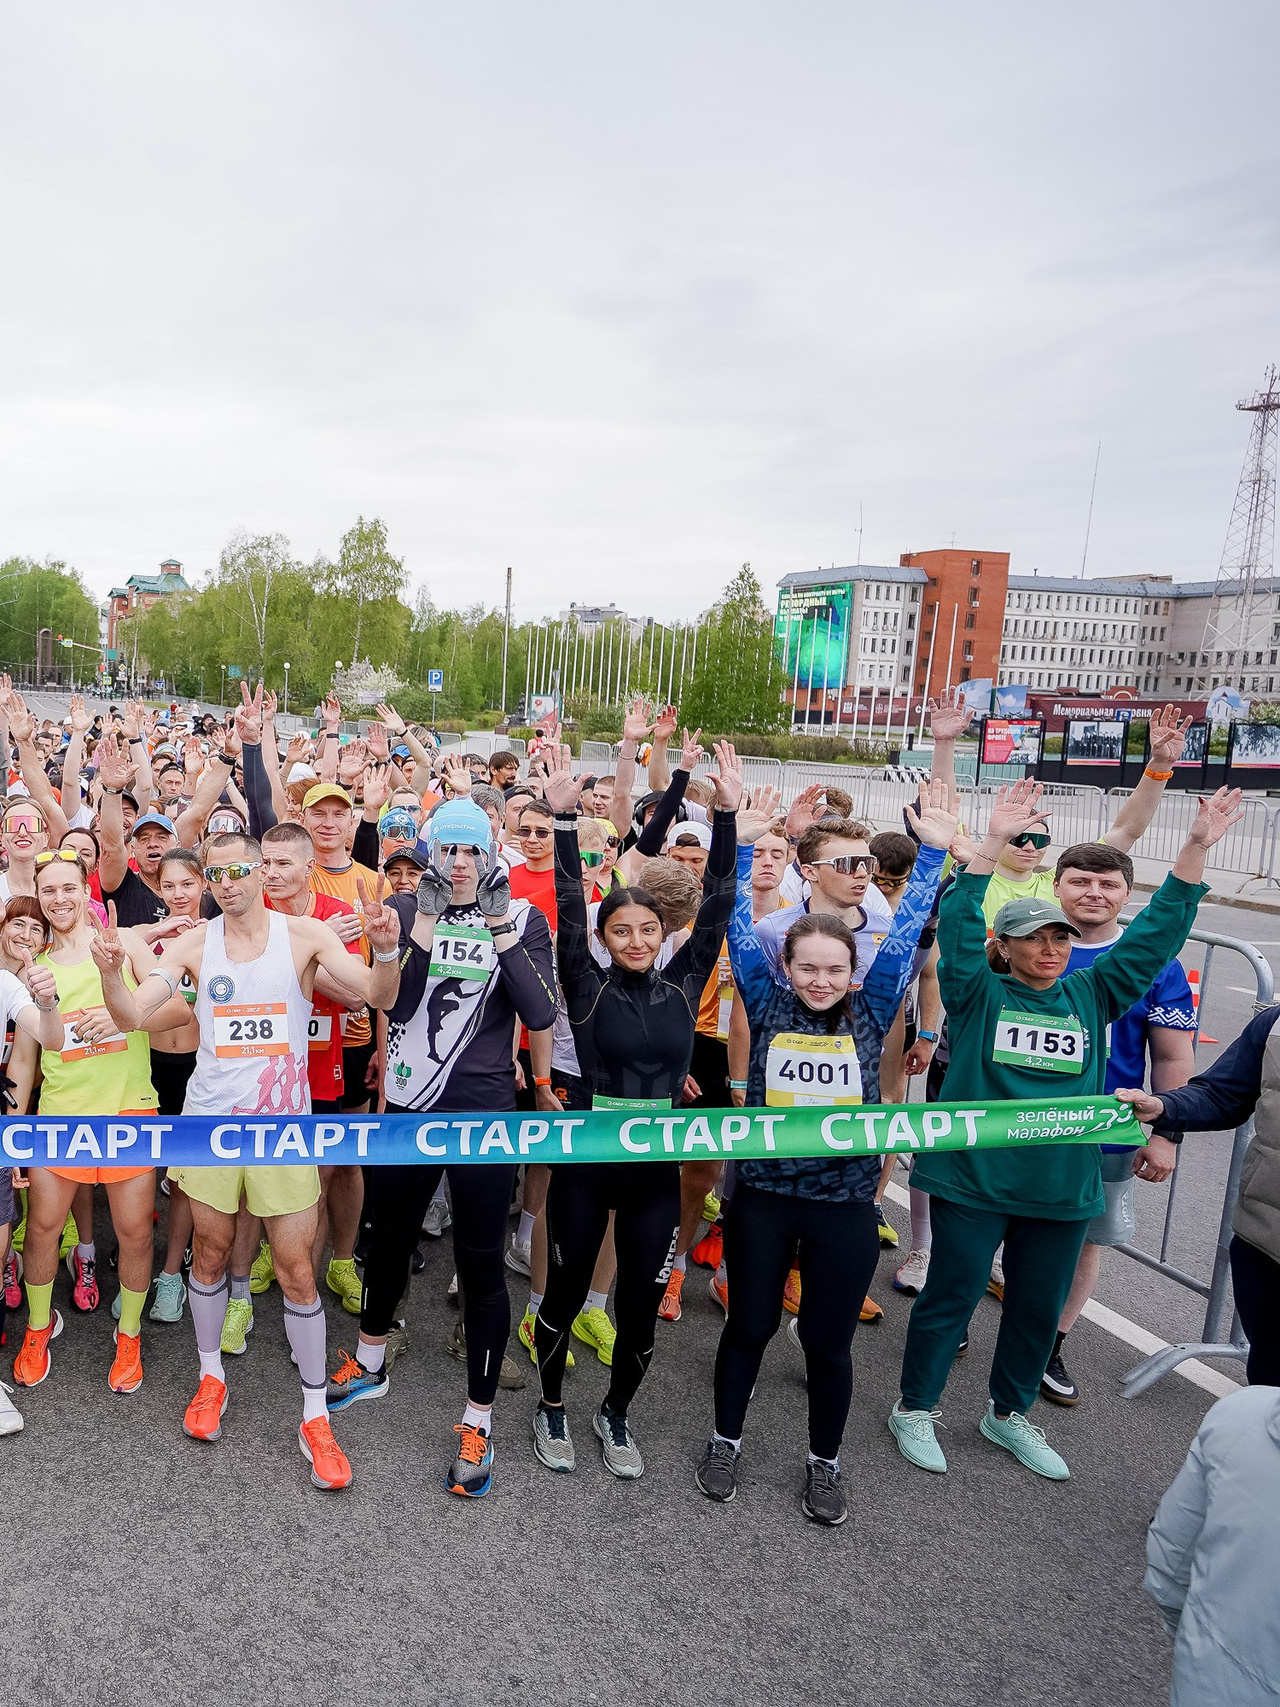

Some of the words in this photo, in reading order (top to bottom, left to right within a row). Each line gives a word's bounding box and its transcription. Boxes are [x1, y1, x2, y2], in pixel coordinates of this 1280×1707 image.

[780, 597, 827, 608] РЕОРДНЫЕ
[1053, 703, 1113, 718] Мемориальная
[438, 940, 484, 965] 154
[229, 1019, 274, 1041] 238
[1007, 1026, 1076, 1056] 1153
[778, 1059, 849, 1086] 4001
[1016, 1105, 1096, 1123] зелёный
[2, 1123, 173, 1160] СТАРТ
[210, 1123, 381, 1159] СТАРТ
[416, 1119, 585, 1156] СТАРТ
[619, 1114, 787, 1154] СТАРТ
[820, 1109, 987, 1150] СТАРТ
[1006, 1123, 1086, 1140] марафон
